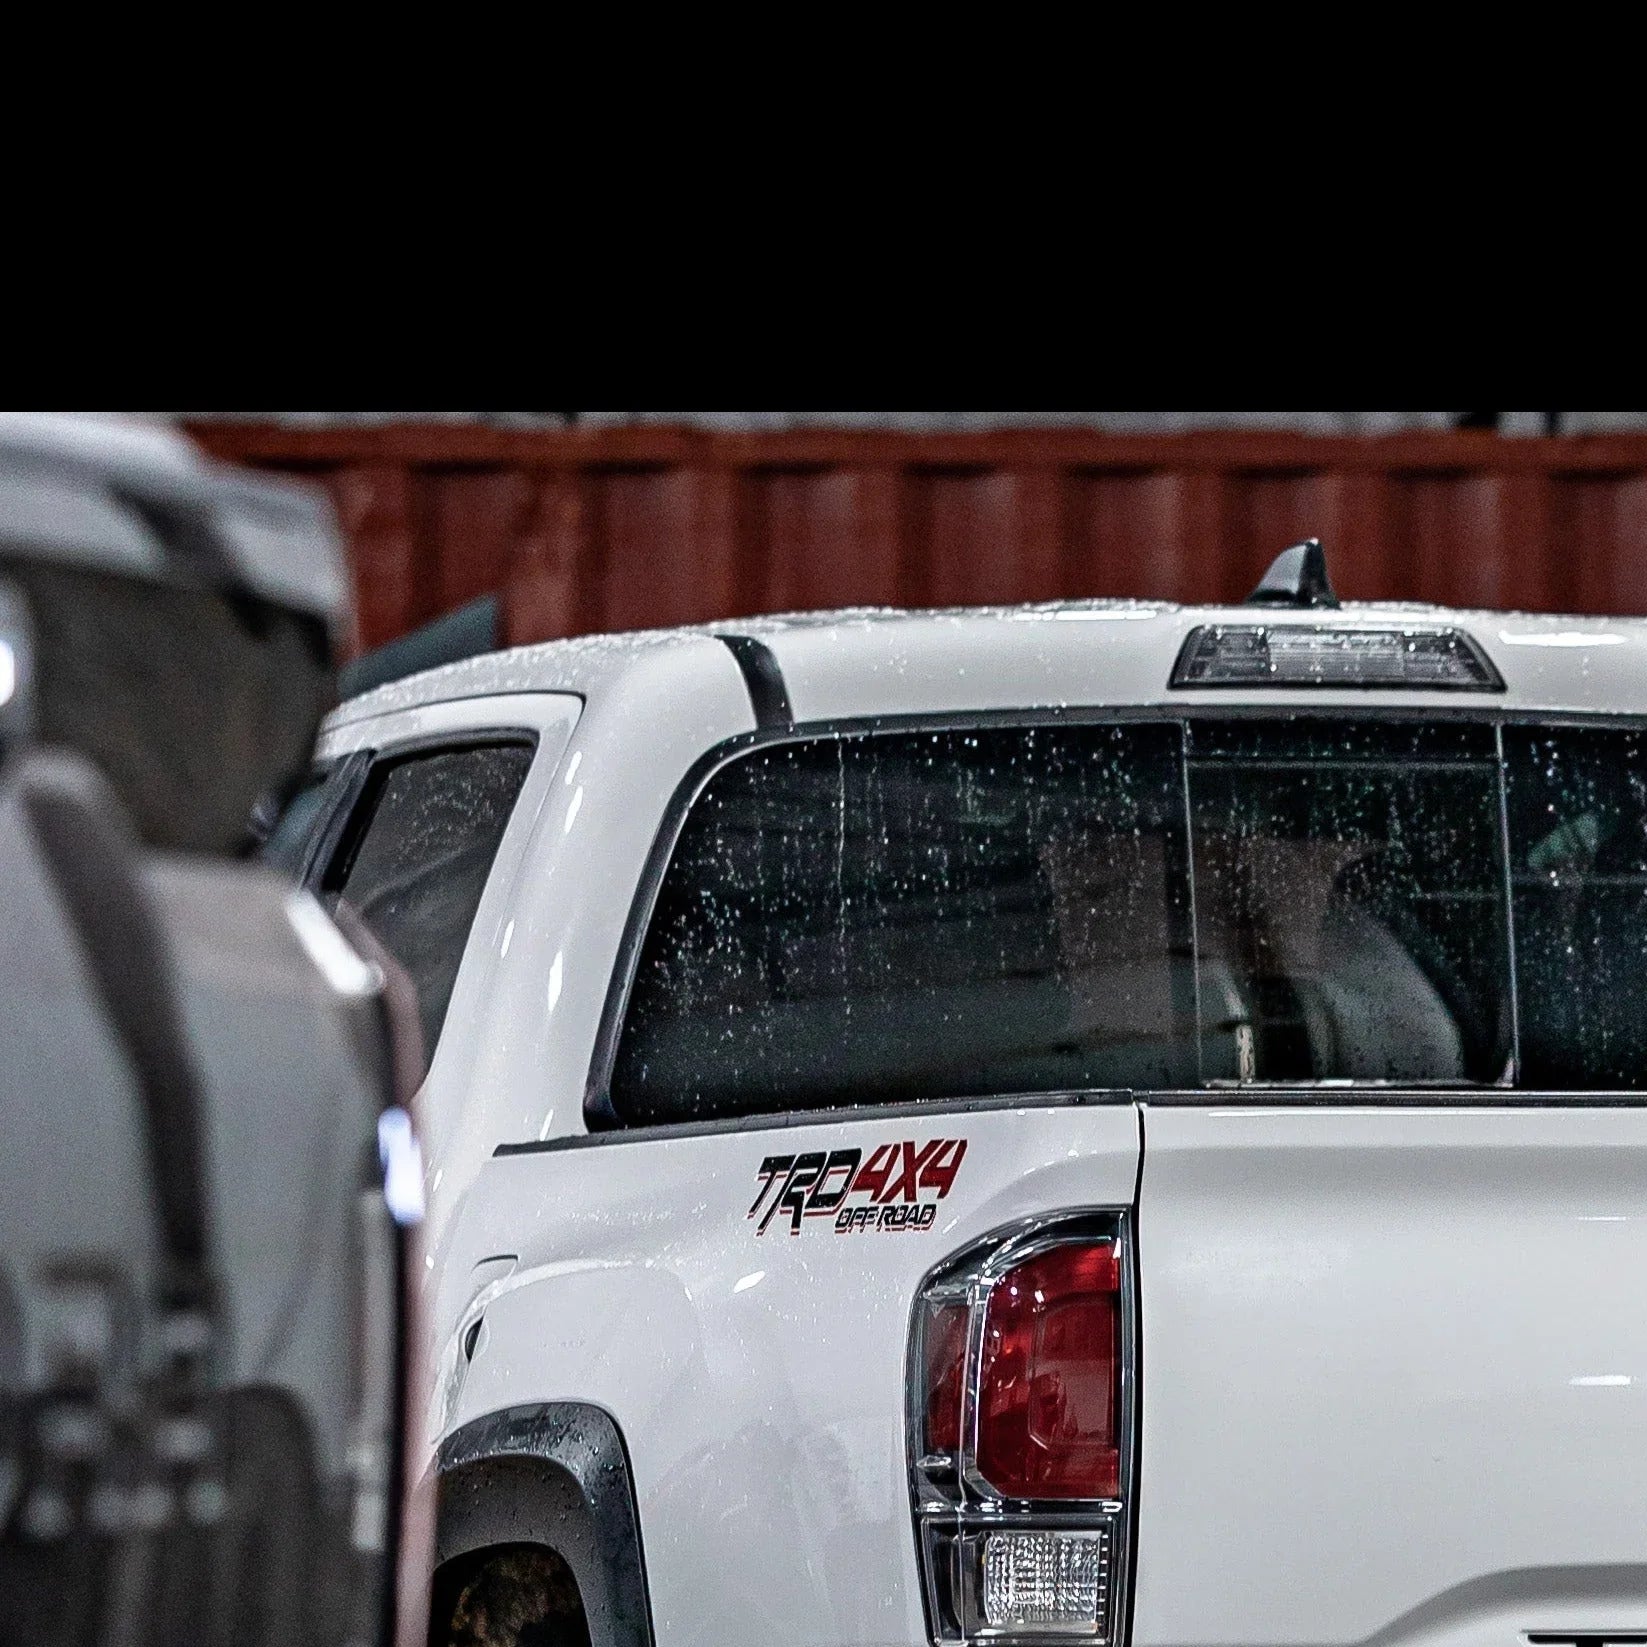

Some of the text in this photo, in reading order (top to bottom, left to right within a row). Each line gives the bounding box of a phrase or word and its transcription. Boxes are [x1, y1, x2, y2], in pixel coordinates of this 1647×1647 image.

[748, 1148, 862, 1236] TRD
[835, 1203, 937, 1233] OFF ROAD
